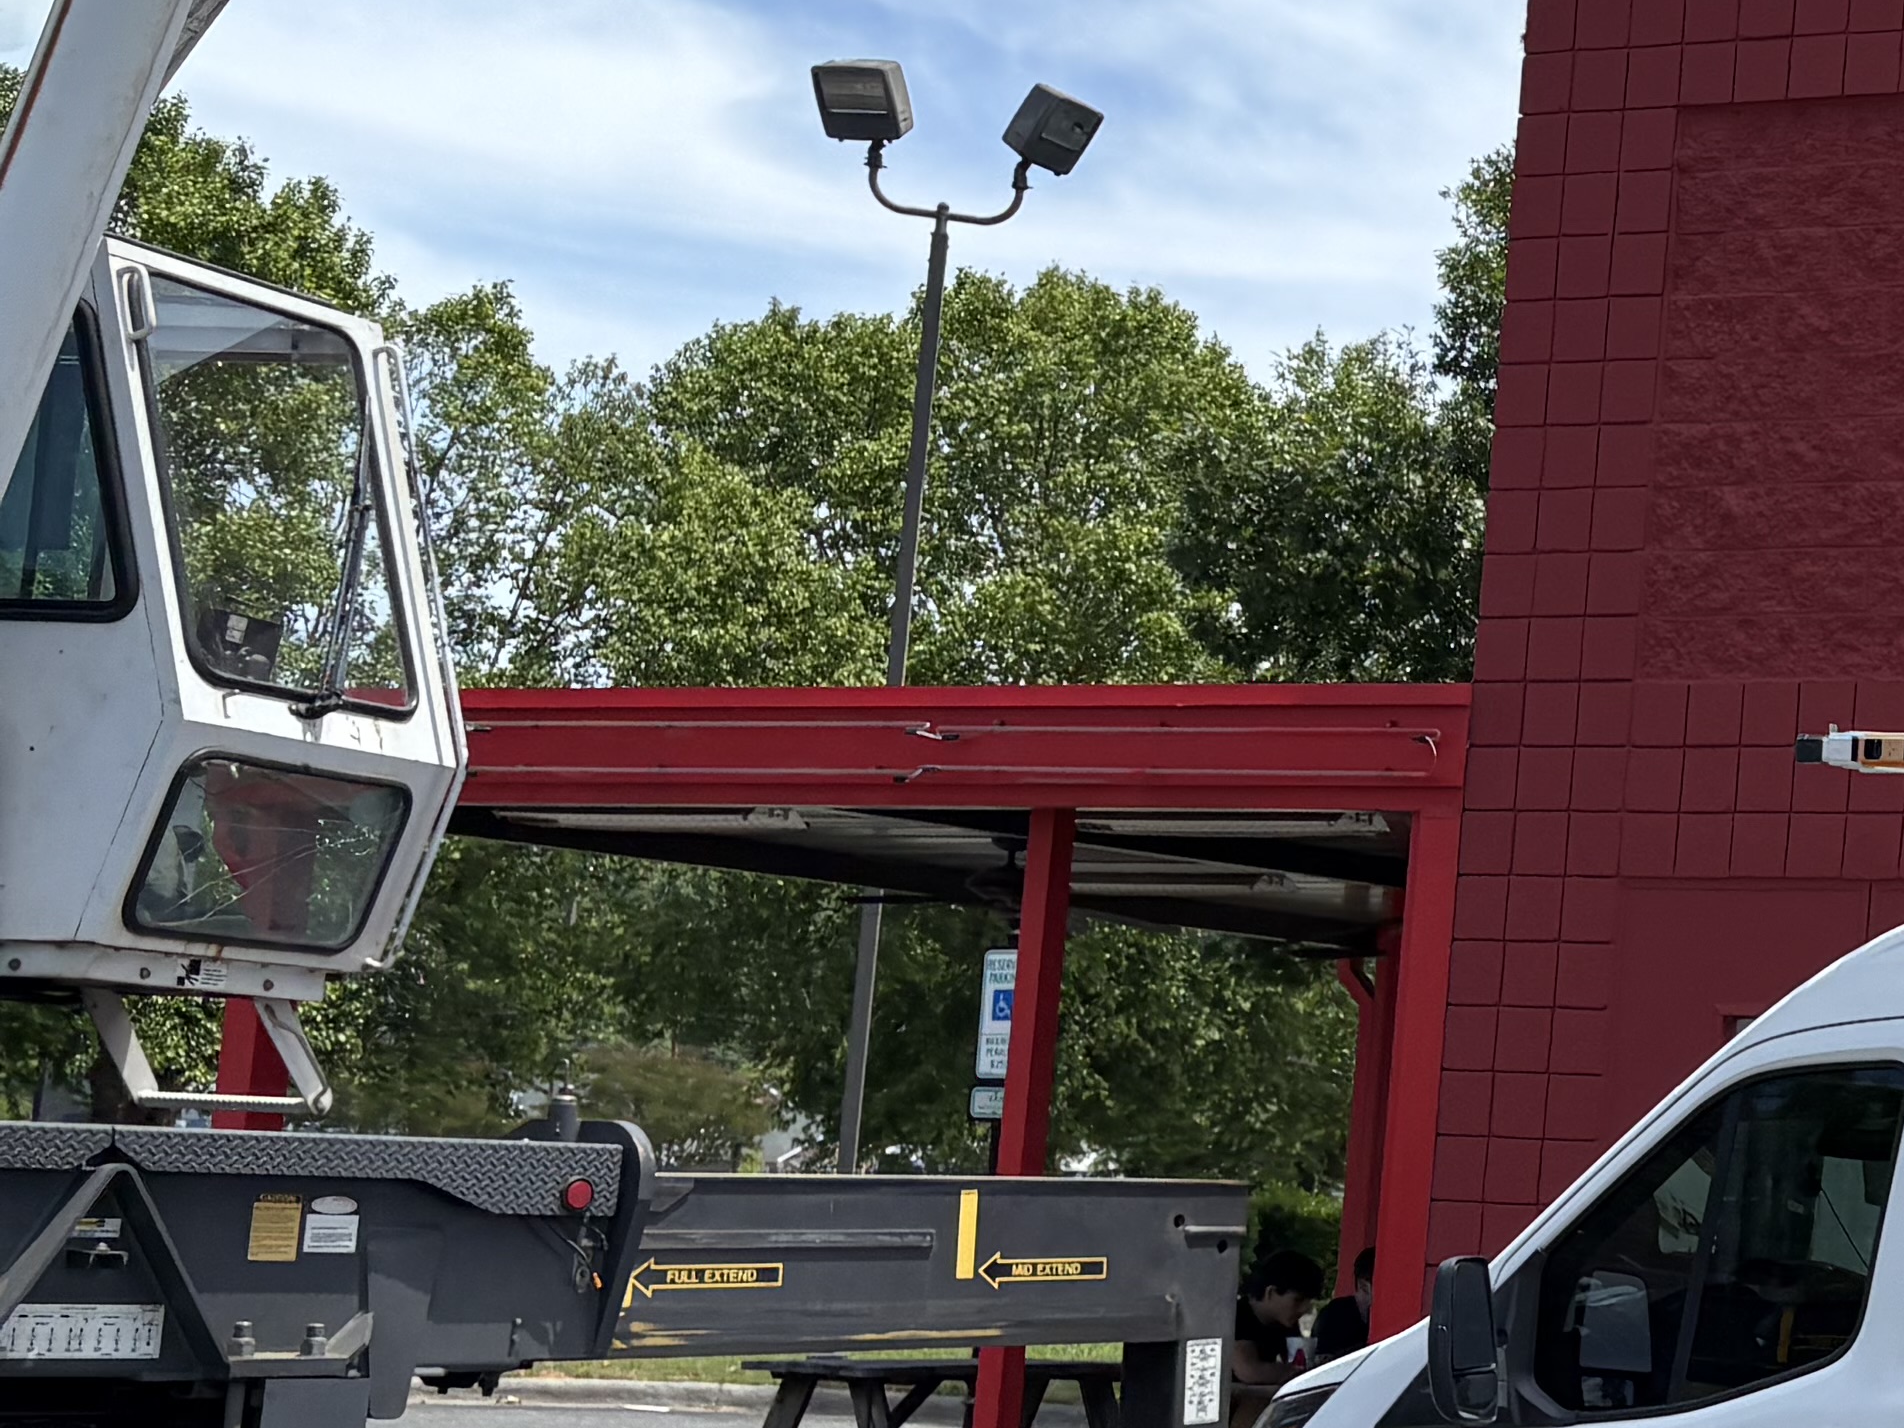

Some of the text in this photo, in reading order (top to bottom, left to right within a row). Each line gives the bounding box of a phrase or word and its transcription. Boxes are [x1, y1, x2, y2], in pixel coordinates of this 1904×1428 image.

[1037, 1262, 1081, 1275] EXTEND
[666, 1269, 757, 1284] FULL EXTEND
